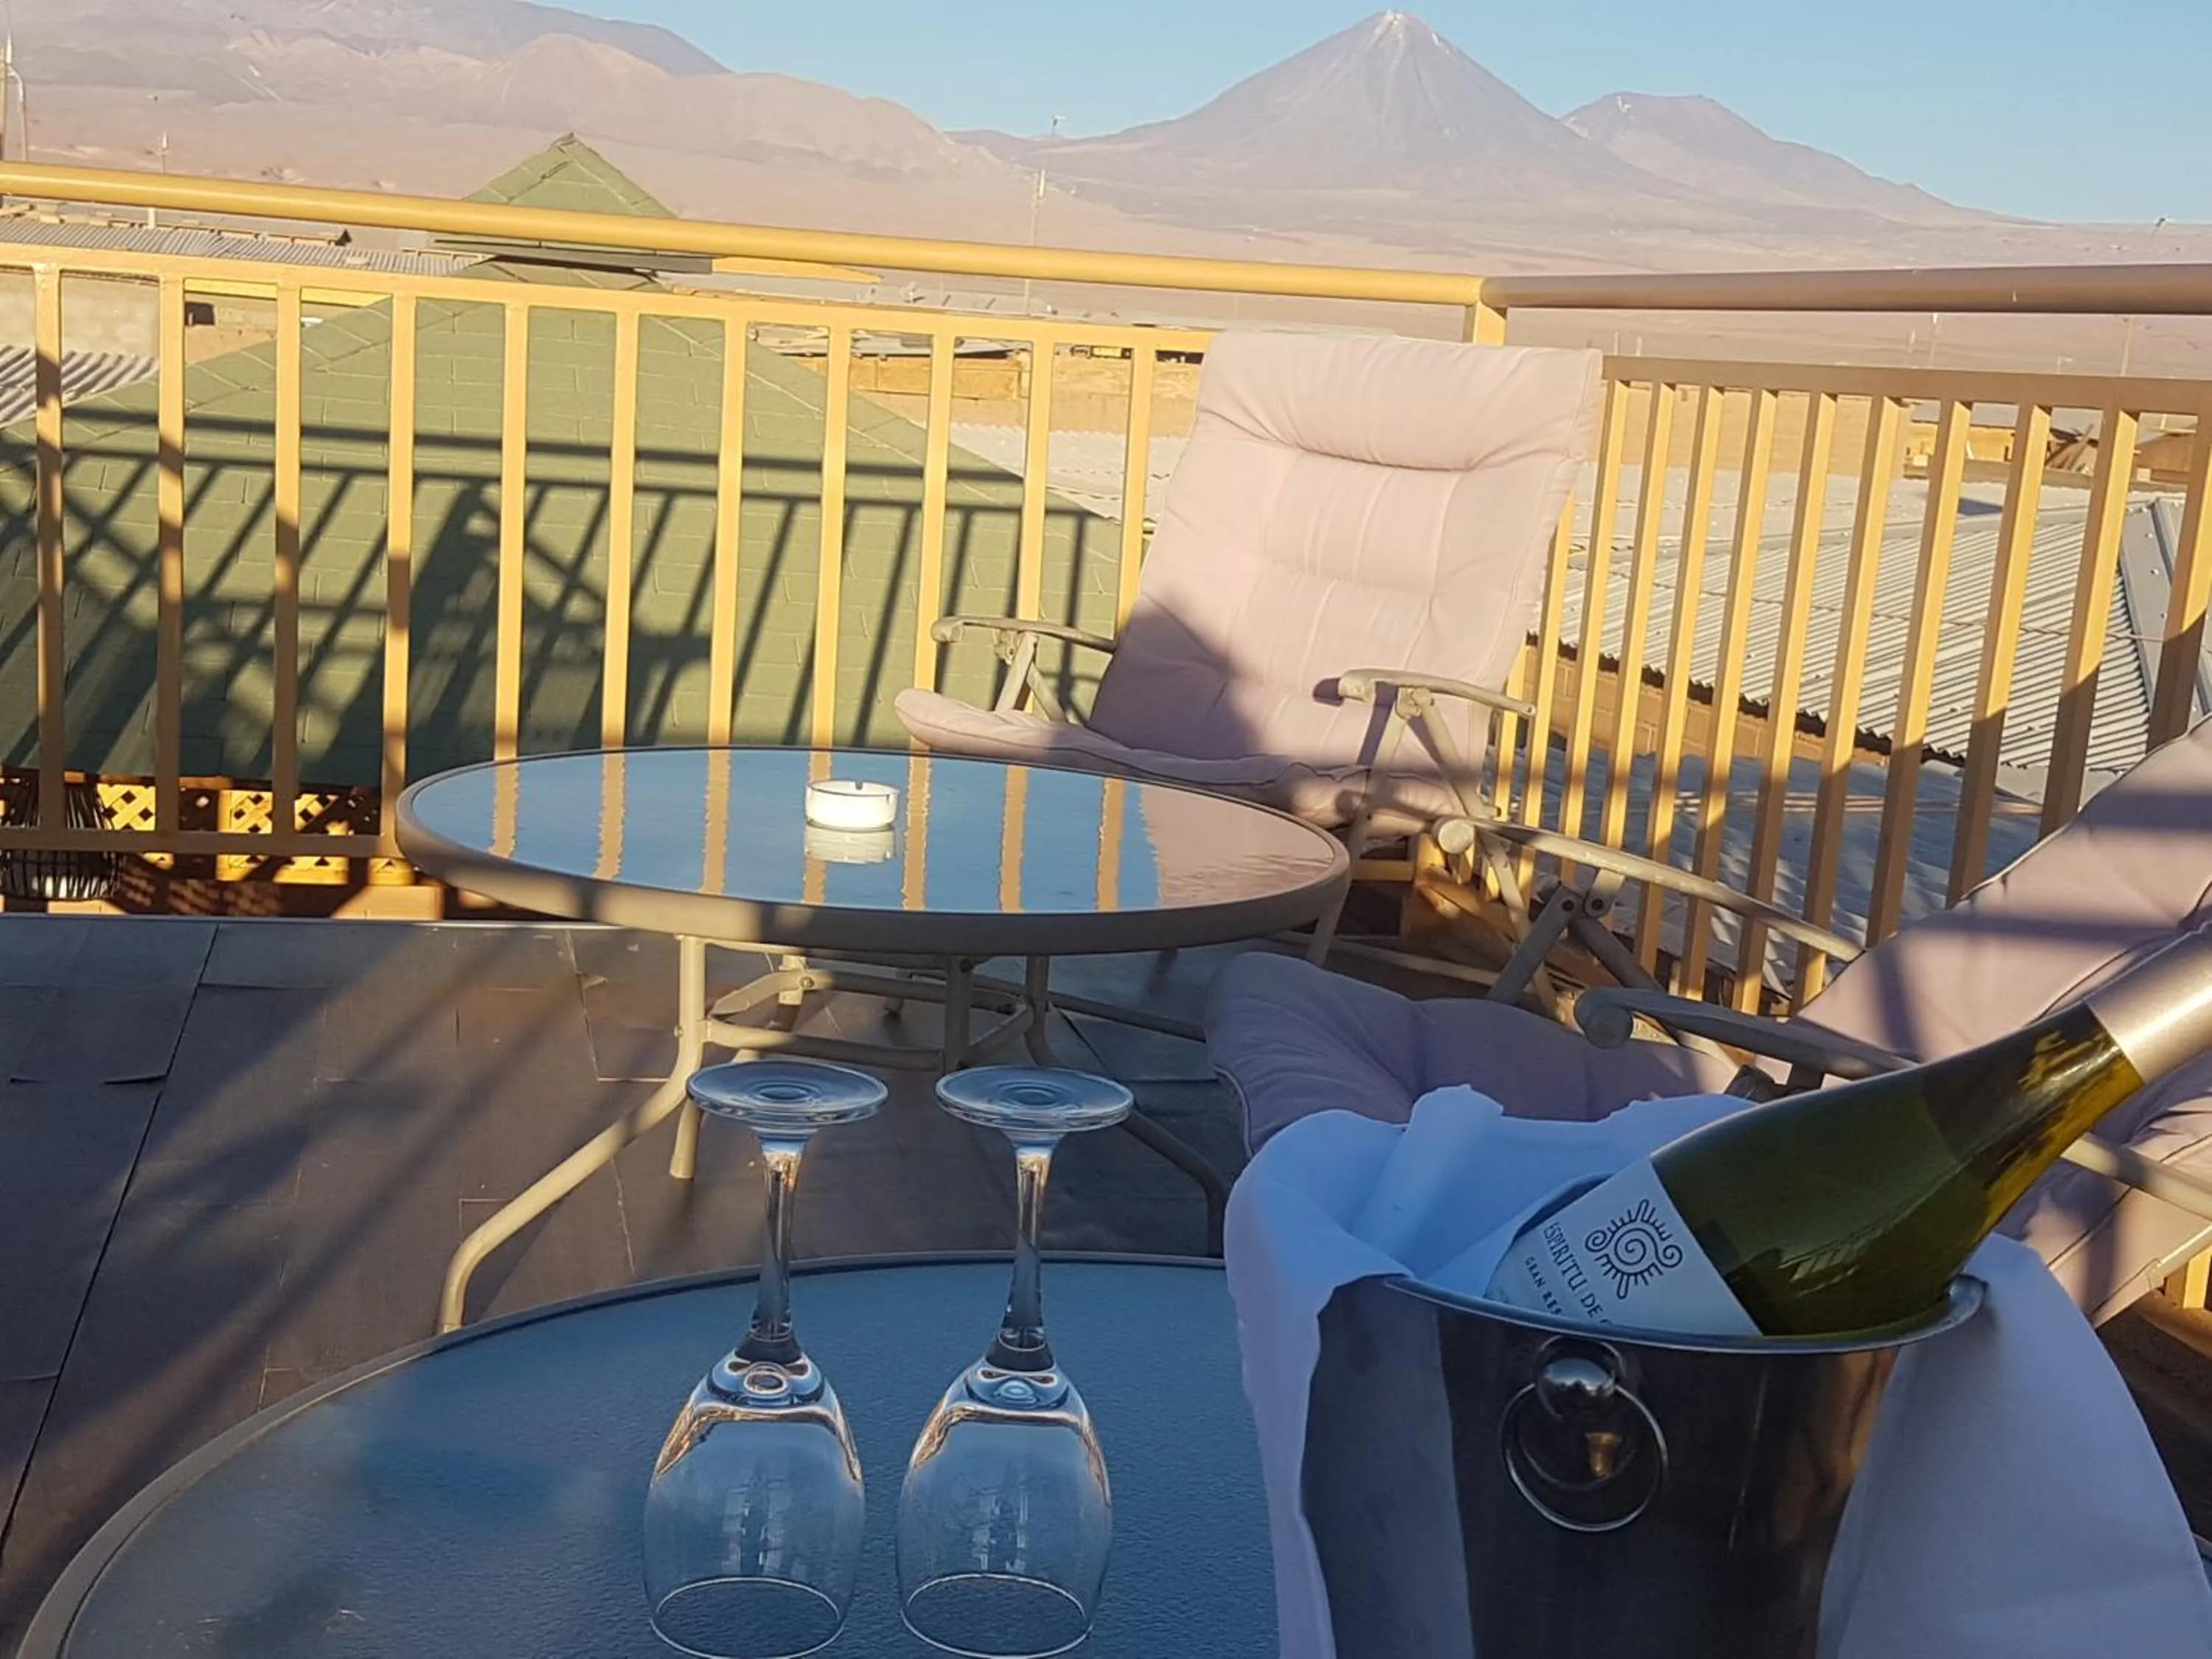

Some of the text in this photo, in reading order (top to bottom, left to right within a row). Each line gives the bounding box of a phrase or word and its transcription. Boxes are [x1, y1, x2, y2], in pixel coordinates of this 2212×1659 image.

[1526, 1256, 1546, 1288] GRAN
[1543, 1221, 1603, 1318] ESPIRITU DE
